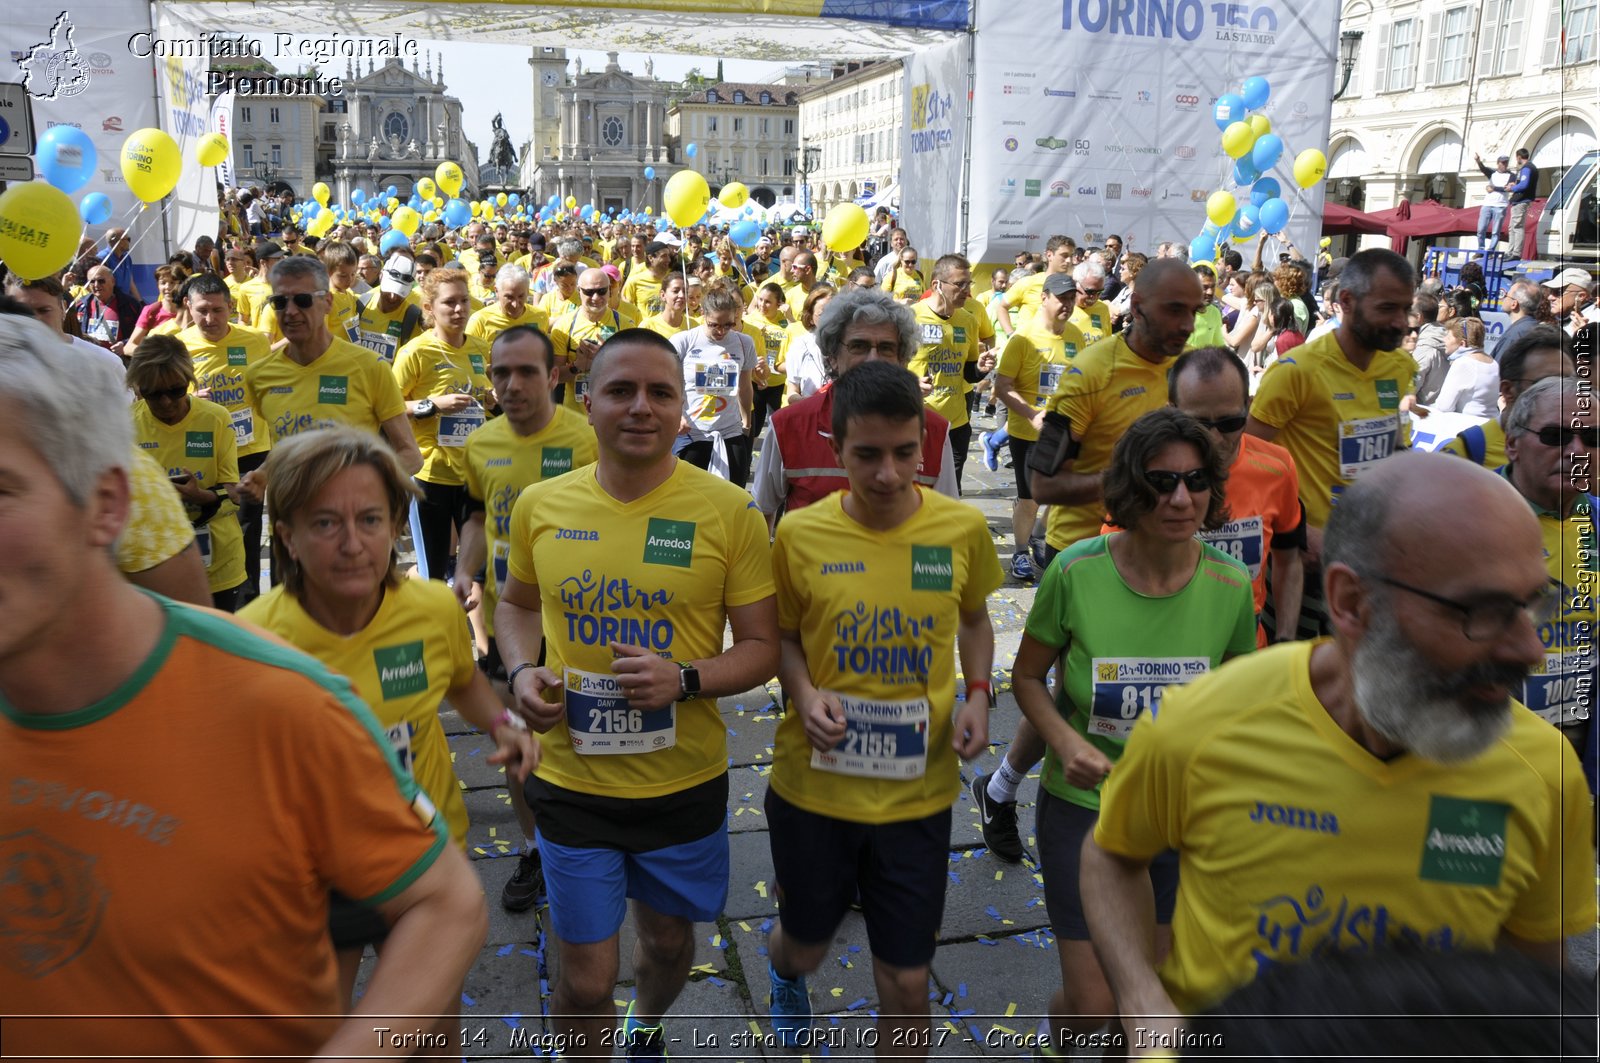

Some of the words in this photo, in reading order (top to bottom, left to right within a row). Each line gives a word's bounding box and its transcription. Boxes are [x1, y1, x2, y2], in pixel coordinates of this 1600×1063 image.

[1062, 0, 1204, 41] TORINO
[1211, 3, 1278, 31] 150
[1216, 31, 1230, 40] LA
[1232, 33, 1275, 44] STAMPA
[911, 129, 936, 154] TORINO
[1078, 187, 1097, 196] Cuki
[1131, 187, 1152, 198] inalpi
[922, 324, 943, 338] 828
[209, 387, 245, 403] ORINO
[319, 386, 347, 395] Arredo3
[186, 441, 213, 449] Arredo3
[542, 457, 571, 469] Arredo3
[647, 535, 691, 550] Arredo3
[913, 561, 952, 576] Arredo3
[606, 578, 675, 611] Stra
[564, 611, 674, 650] TORINO
[879, 607, 935, 639] Stra
[833, 645, 932, 675] TORINO
[1183, 662, 1206, 671] 150
[381, 658, 424, 683] Arredo3
[597, 699, 616, 708] DANY
[588, 708, 643, 733] 2156
[844, 729, 897, 759] 2155
